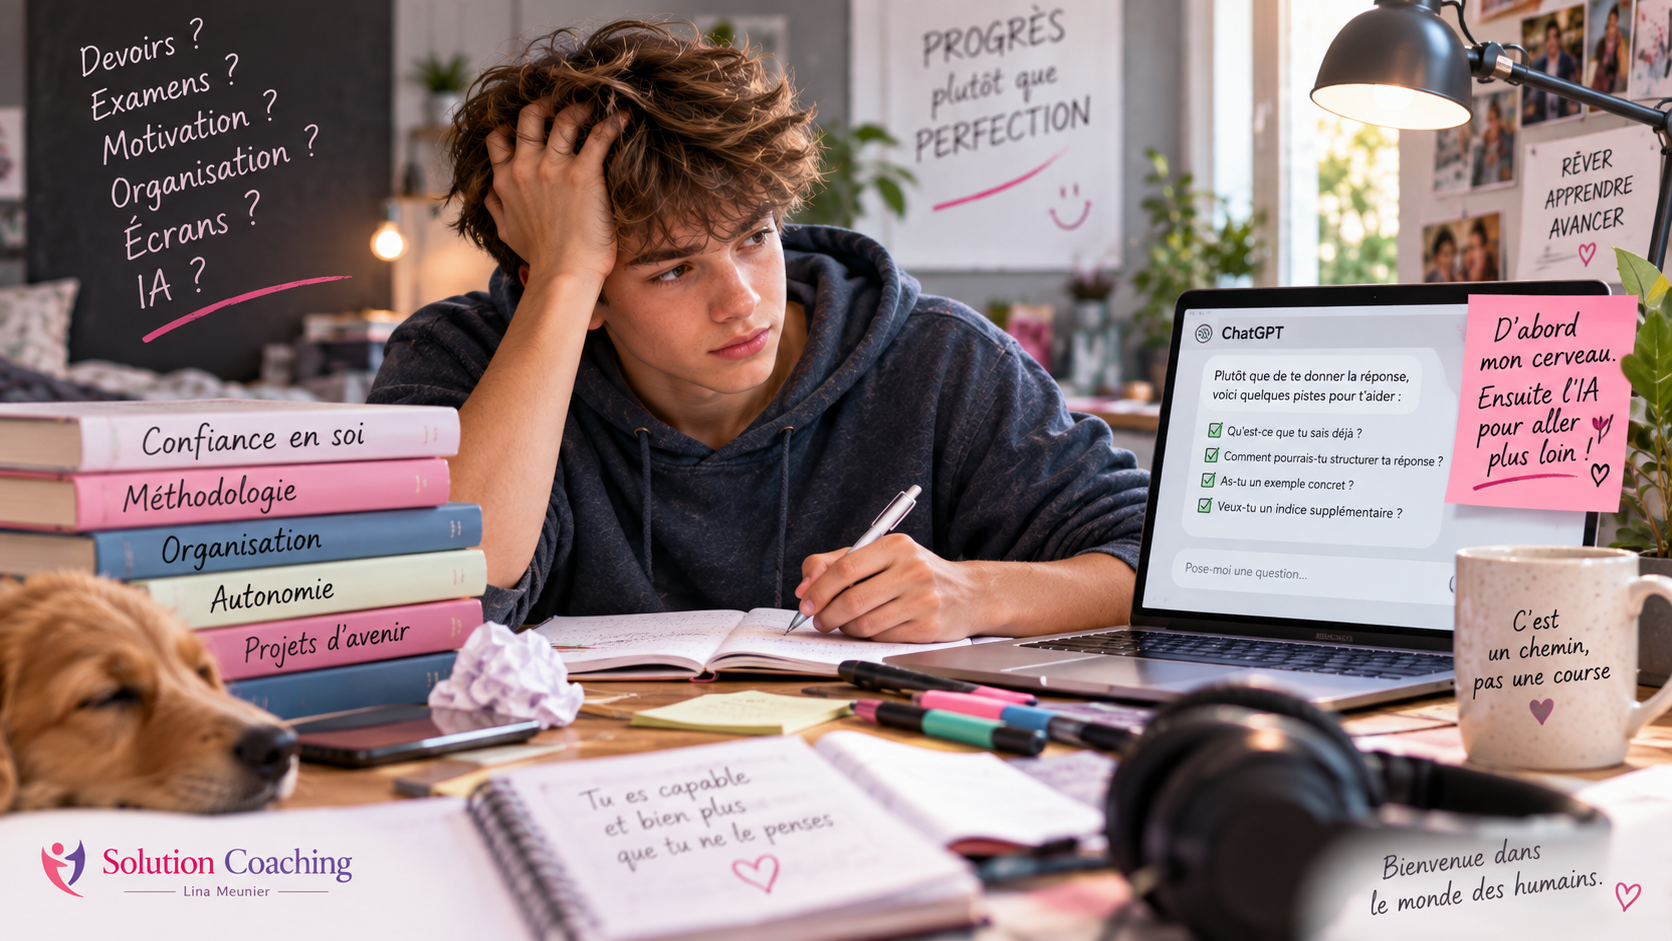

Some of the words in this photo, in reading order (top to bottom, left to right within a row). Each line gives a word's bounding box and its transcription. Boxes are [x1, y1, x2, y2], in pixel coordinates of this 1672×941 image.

[80, 35, 175, 77] Devoirs
[190, 17, 203, 49] ?
[922, 5, 1066, 68] PROGRÈS
[91, 73, 210, 121] Examens
[225, 53, 239, 85] ?
[932, 68, 1003, 120] plutôt
[1015, 66, 1057, 103] que
[103, 110, 249, 165] Motivation
[262, 89, 277, 121] ?
[916, 95, 1090, 163] PERFECTION
[111, 145, 290, 211] Organisation
[304, 124, 319, 156] ?
[1545, 175, 1633, 209] APPRENDRE
[124, 215, 228, 260] Écrans
[244, 189, 260, 225] ?
[1549, 207, 1624, 239] AVANCER
[137, 268, 172, 308] IA
[190, 257, 205, 292] ?
[1222, 326, 1284, 340] ChatGPT
[1214, 370, 1246, 382] Plutôt
[1250, 373, 1270, 385] que
[1273, 371, 1287, 382] de
[1290, 372, 1301, 382] te
[1304, 371, 1345, 382] donner
[1347, 371, 1357, 382] la
[1360, 371, 1410, 385] réponse,
[1480, 355, 1522, 371] mon
[1532, 349, 1616, 367] cerveau.
[1212, 390, 1237, 400] voici
[1240, 390, 1290, 403] quelques
[1293, 391, 1325, 403] pistes
[1329, 393, 1356, 404] pour
[1478, 383, 1552, 409] Ensuite
[142, 422, 277, 460] Confiance
[289, 430, 319, 447] en
[332, 422, 364, 446] soi
[1276, 429, 1294, 440] que
[1298, 428, 1308, 438] tu
[1310, 428, 1329, 438] sais
[1332, 428, 1354, 439] déjà
[1357, 428, 1362, 438] ?
[1477, 422, 1523, 448] pour
[1532, 408, 1580, 434] aller
[1224, 452, 1271, 462] Comment
[1274, 454, 1327, 464] pourrais-tu
[1330, 455, 1378, 466] structurer
[1382, 456, 1391, 466] ta
[1394, 455, 1434, 468] réponse
[1438, 456, 1443, 467] ?
[1487, 442, 1529, 477] plus
[1539, 439, 1576, 464] loin
[1585, 437, 1593, 461] !
[123, 475, 297, 514] Méthodologie
[1220, 476, 1246, 487] As-tu
[1250, 479, 1261, 487] un
[1264, 478, 1305, 490] exemple
[1308, 480, 1346, 490] concret
[1348, 480, 1354, 490] ?
[1218, 501, 1256, 512] Veux-tu
[1260, 505, 1272, 514] un
[1276, 503, 1306, 515] indice
[1310, 506, 1393, 518] supplémentaire
[1397, 508, 1402, 518] ?
[162, 528, 322, 571] Organisation
[1186, 562, 1232, 576] Pose-moi
[1234, 567, 1252, 576] une
[211, 578, 334, 613] Autonomie
[245, 632, 317, 668] Projets
[1489, 648, 1510, 661] un
[1520, 635, 1589, 658] chemin,
[1473, 675, 1503, 700] pas
[1513, 672, 1544, 686] une
[1554, 666, 1611, 683] course
[579, 788, 614, 810] Tu
[626, 790, 648, 804] es
[659, 767, 751, 800] capable
[604, 816, 628, 836] et
[637, 810, 690, 830] bien
[700, 797, 746, 827] plus
[618, 845, 658, 872] que
[664, 837, 692, 855] tu
[700, 834, 727, 849] ne
[732, 822, 755, 842] le
[764, 814, 834, 845] penses
